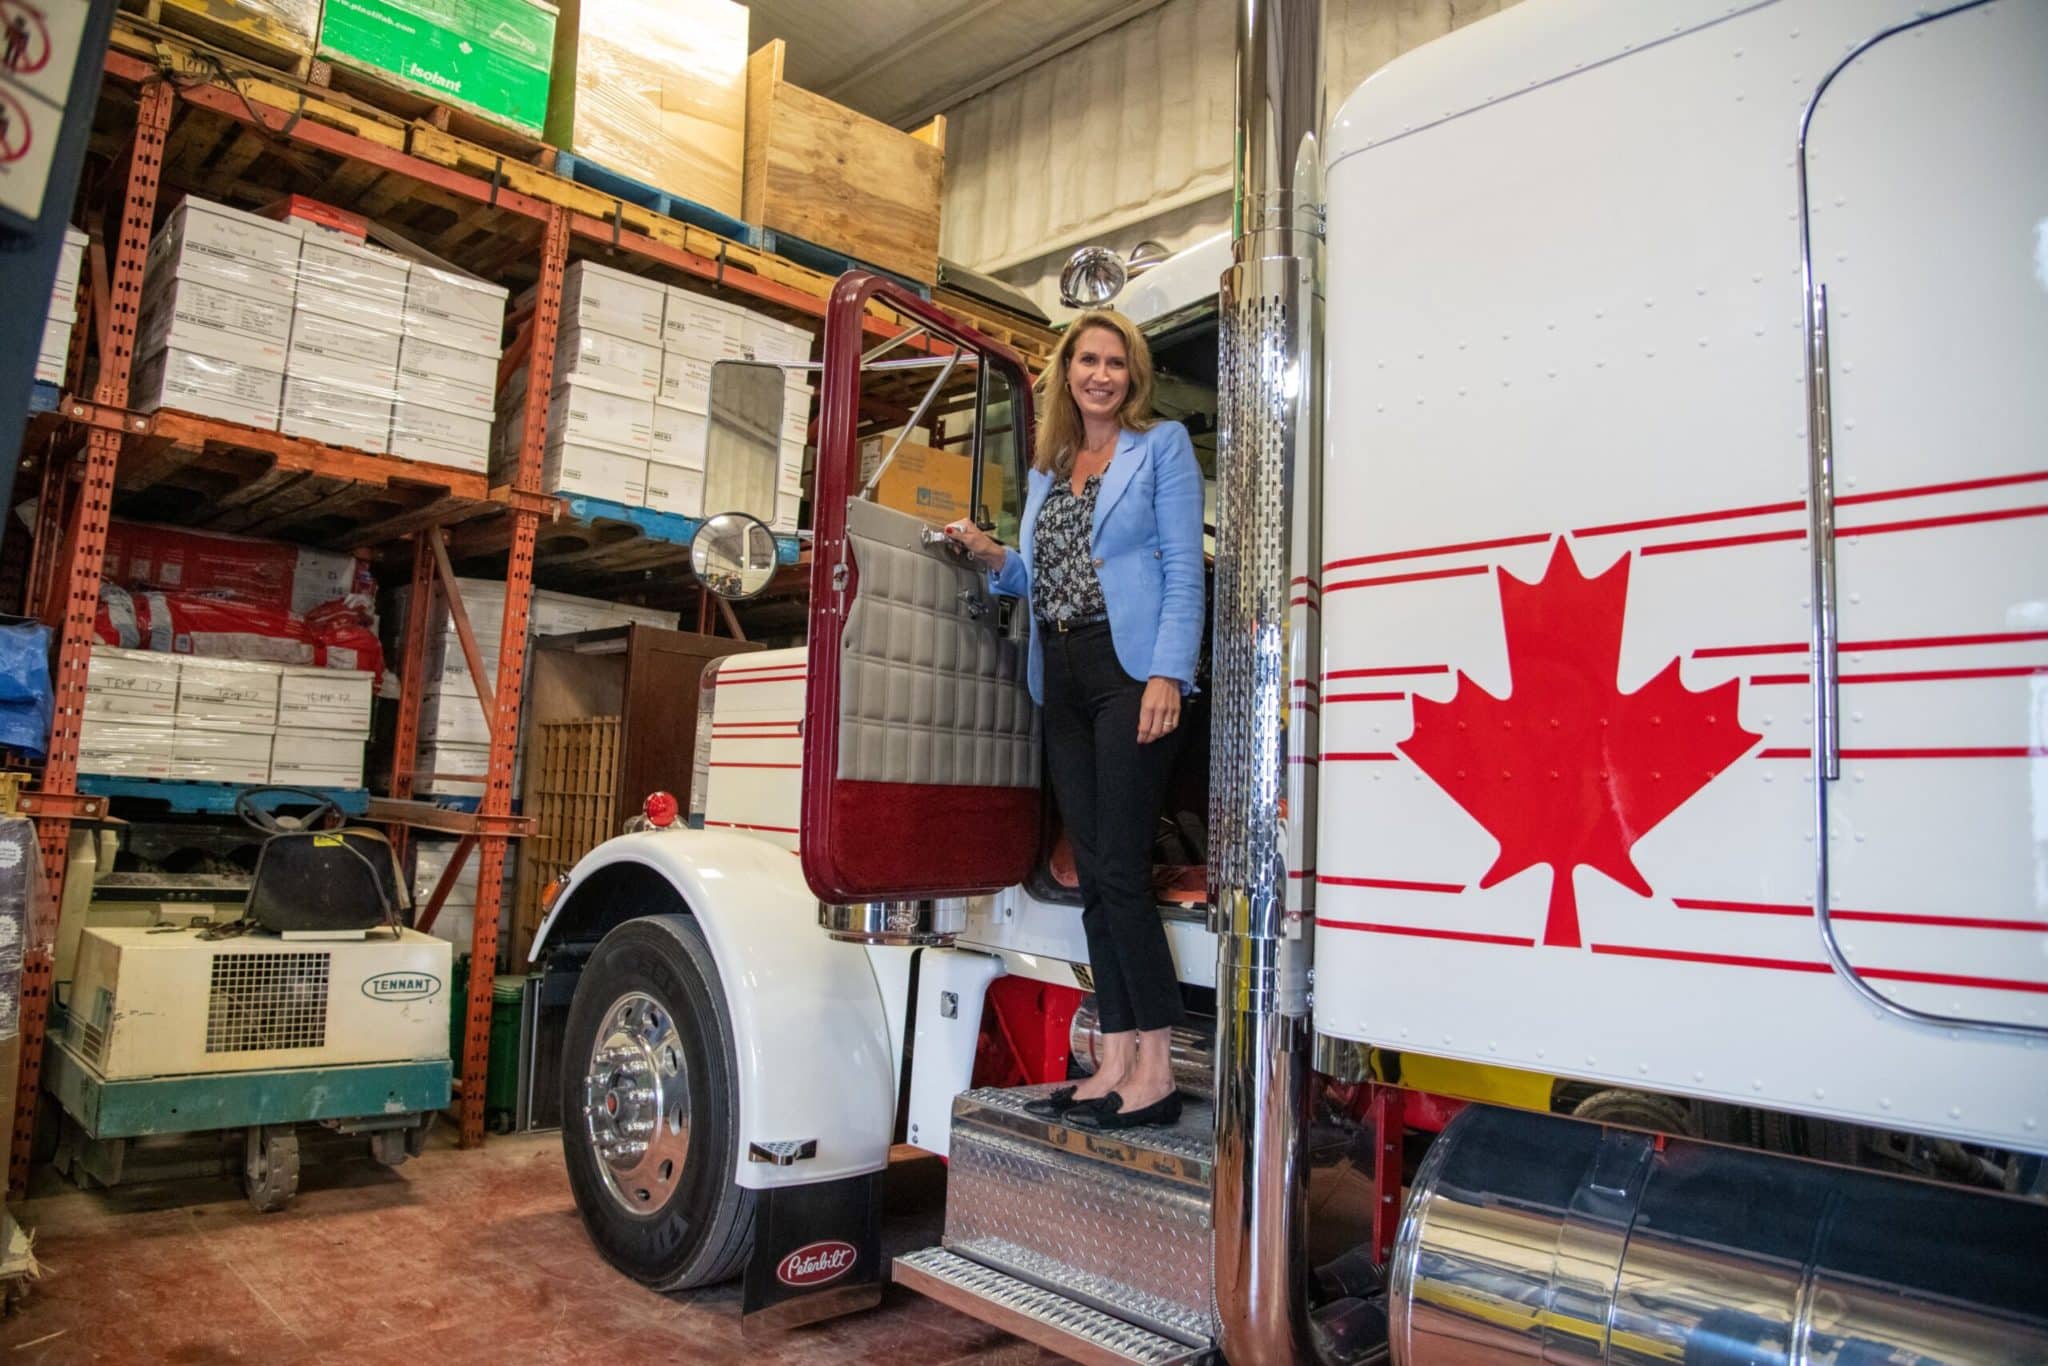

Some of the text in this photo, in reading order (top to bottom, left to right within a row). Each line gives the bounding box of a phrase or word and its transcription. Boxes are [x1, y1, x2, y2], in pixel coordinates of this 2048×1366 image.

[410, 62, 462, 93] Isolant
[373, 979, 432, 994] TENNANT
[787, 1249, 851, 1280] Peterbilt
